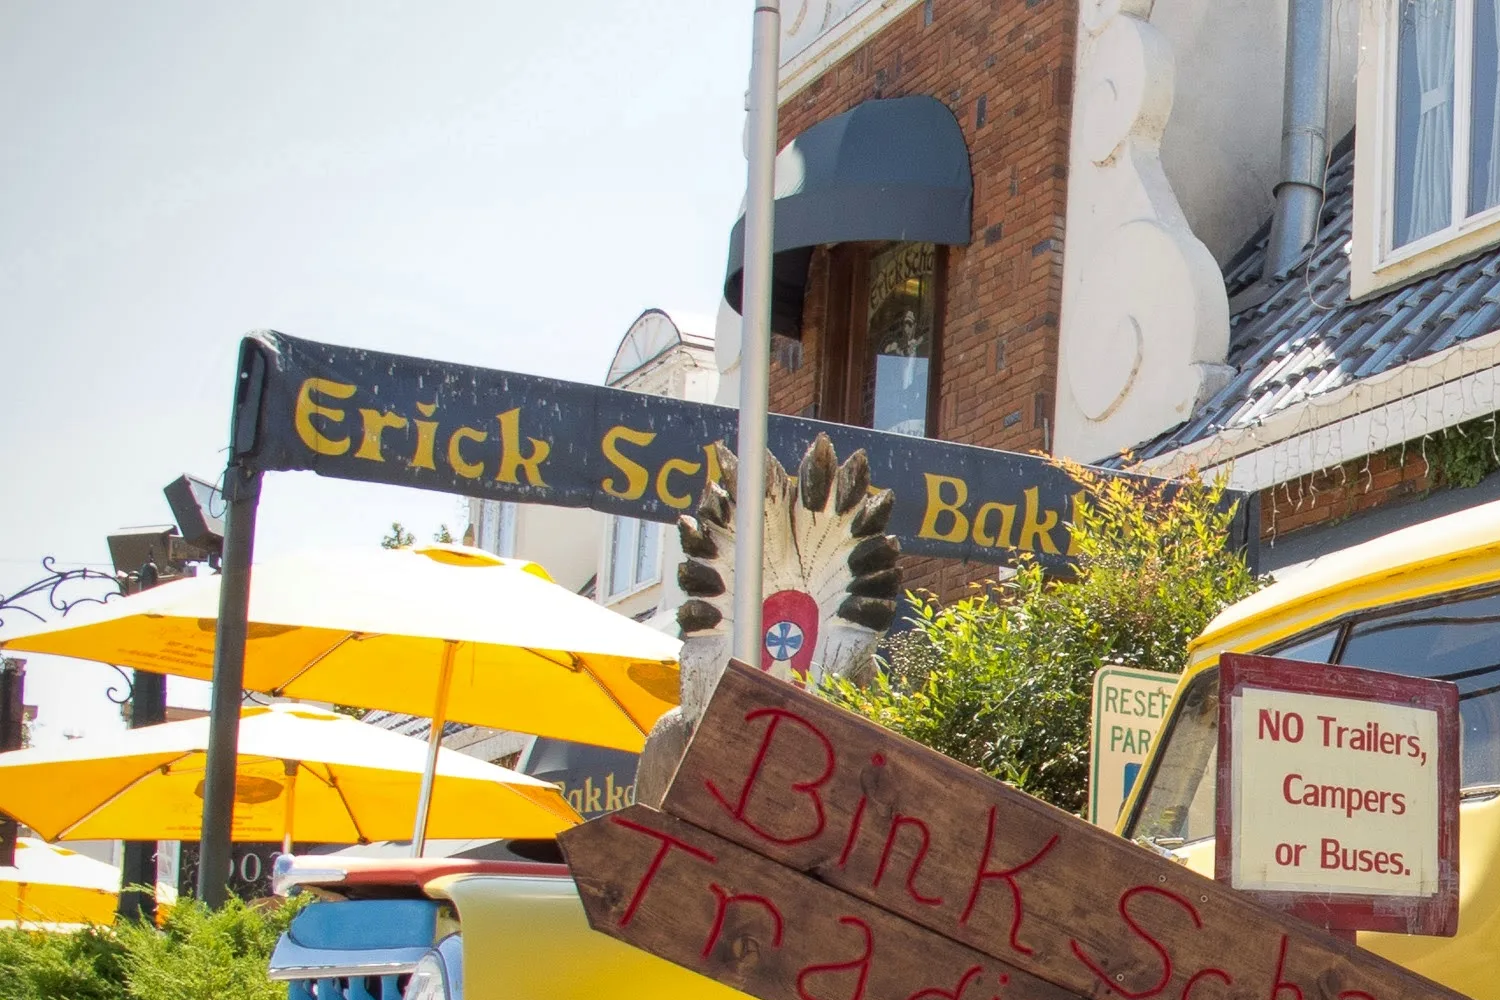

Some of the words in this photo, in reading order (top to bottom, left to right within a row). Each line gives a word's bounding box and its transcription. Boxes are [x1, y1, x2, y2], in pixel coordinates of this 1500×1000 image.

[294, 376, 550, 488] Erick
[601, 425, 722, 509] Sc
[1111, 725, 1155, 755] PAR
[1258, 709, 1304, 743] NO
[1317, 715, 1427, 766] Trailers,
[1283, 773, 1406, 818] Campers
[1275, 842, 1307, 867] or
[1320, 838, 1411, 876] Buses.
